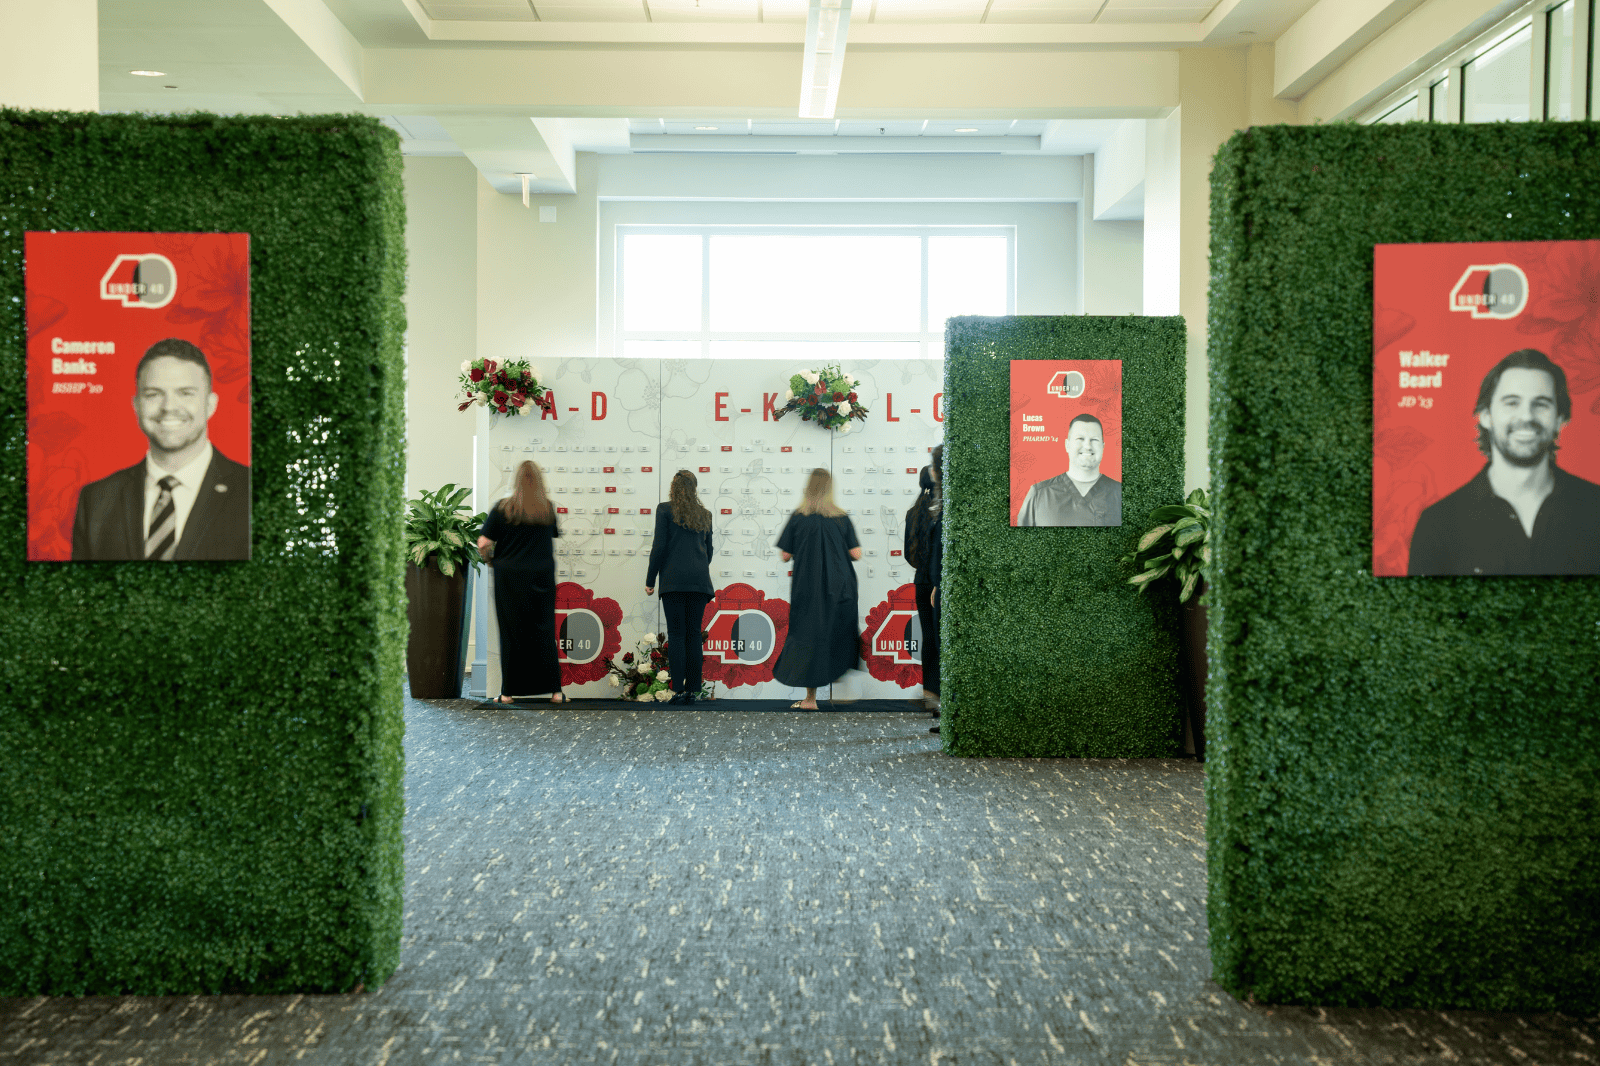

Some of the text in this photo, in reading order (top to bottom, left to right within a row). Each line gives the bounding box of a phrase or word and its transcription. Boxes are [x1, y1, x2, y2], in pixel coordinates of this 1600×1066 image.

[52, 337, 115, 354] Cameron
[1398, 350, 1450, 367] Walker
[52, 358, 97, 375] Banks
[1399, 370, 1443, 388] Beard
[1397, 395, 1416, 408] JD
[1022, 413, 1043, 422] Lucas
[1022, 423, 1045, 433] Brown
[577, 639, 591, 650] 40
[707, 640, 762, 651] UNDER 40
[880, 640, 917, 651] UNDER
